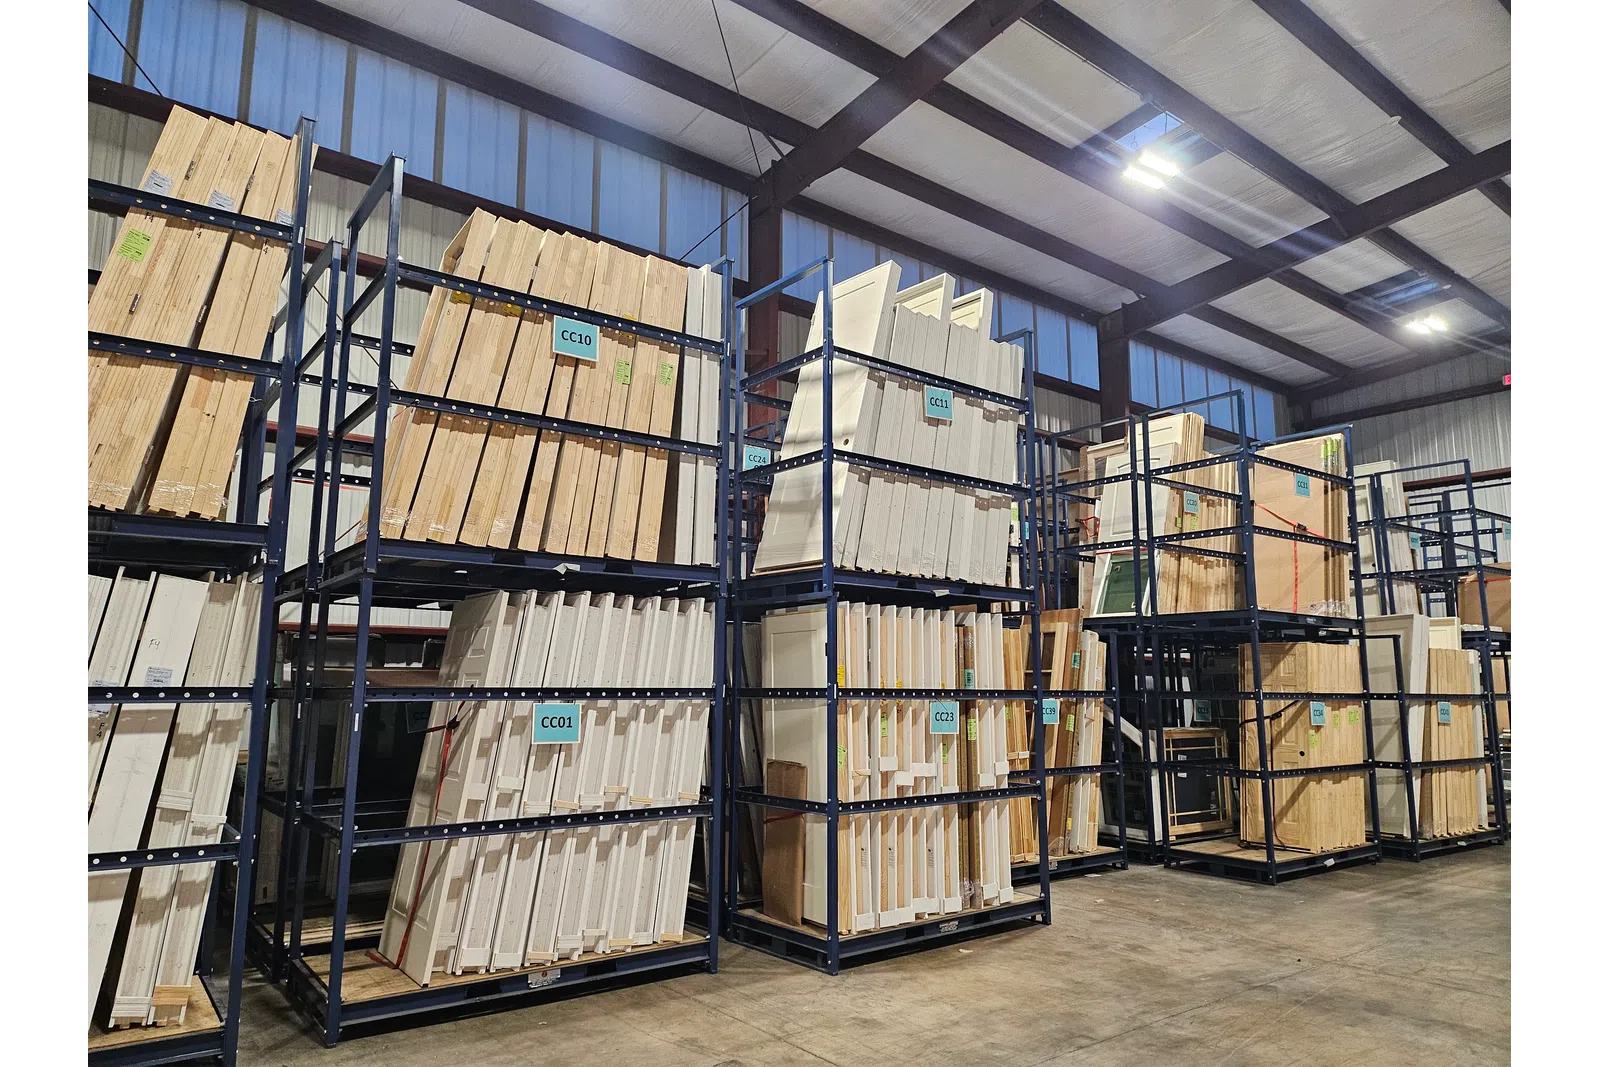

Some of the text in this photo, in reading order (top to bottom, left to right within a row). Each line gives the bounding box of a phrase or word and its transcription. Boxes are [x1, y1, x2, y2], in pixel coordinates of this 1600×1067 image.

[561, 330, 592, 346] CC10
[930, 396, 949, 409] CC11
[748, 454, 766, 464] CC24
[1297, 480, 1308, 489] CC31
[934, 711, 955, 722] CC23
[1042, 707, 1056, 715] CC39
[541, 716, 573, 729] CC01
